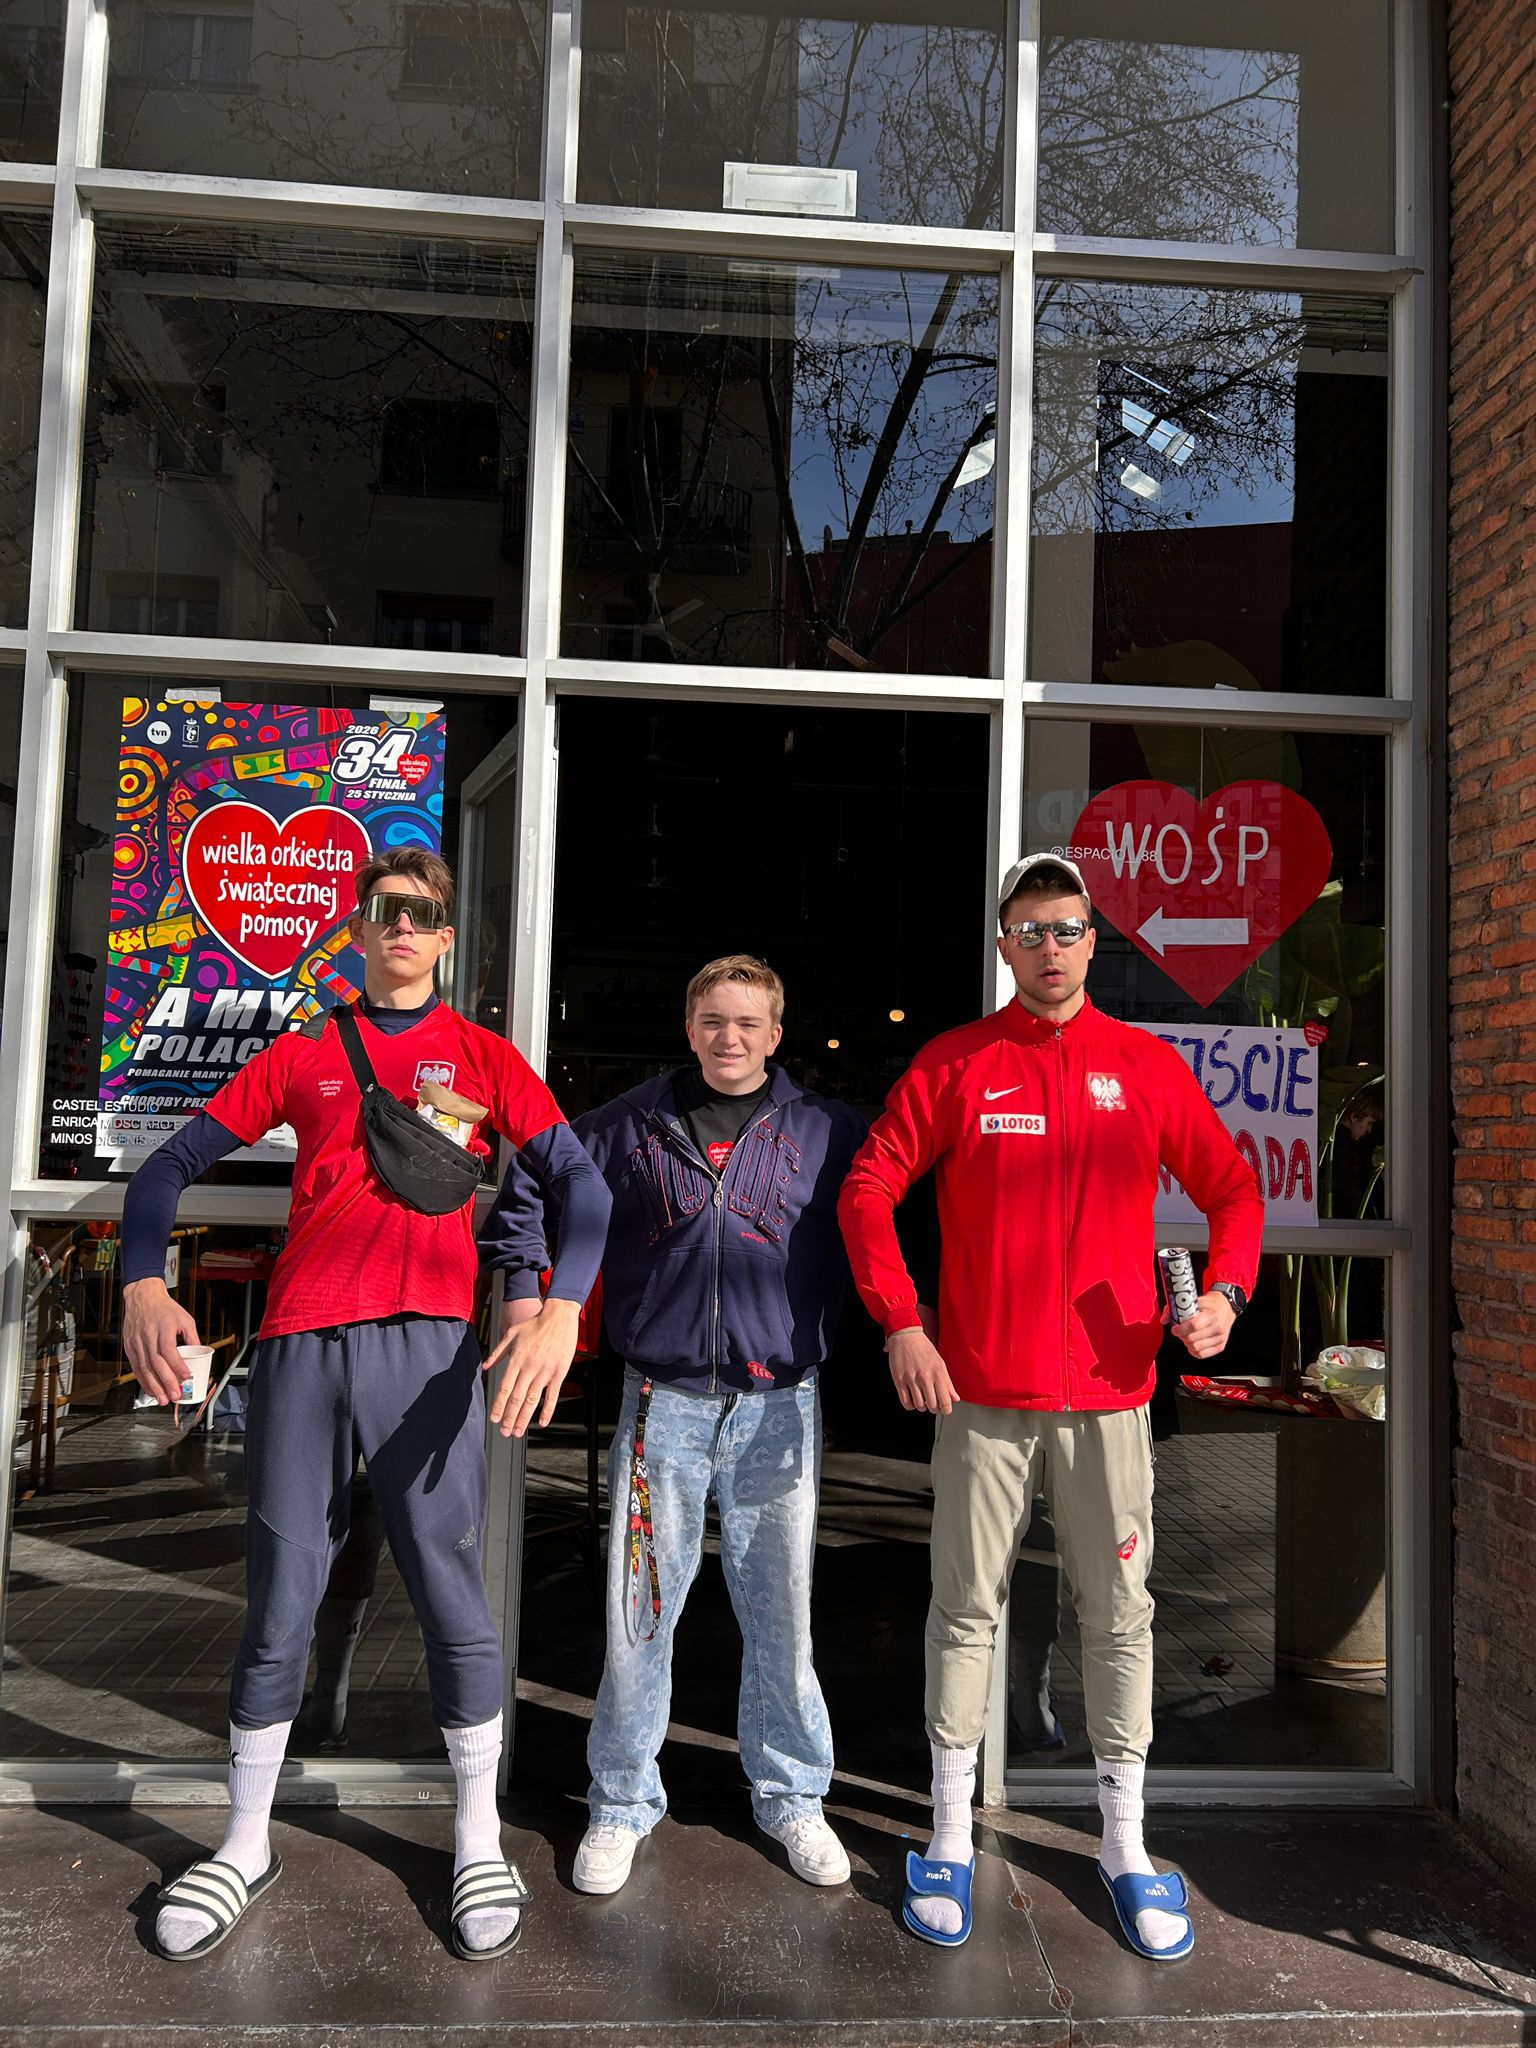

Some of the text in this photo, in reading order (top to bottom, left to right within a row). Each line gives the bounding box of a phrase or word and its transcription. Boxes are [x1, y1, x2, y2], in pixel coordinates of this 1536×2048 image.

[150, 727, 167, 736] tvn
[346, 725, 379, 734] 2026
[333, 730, 415, 783] 34
[346, 789, 416, 801] 25 STYCZNIA
[201, 832, 354, 872] wielka orkiestra
[1105, 806, 1269, 887] WOŚP
[217, 870, 338, 920] świątecznej
[239, 912, 319, 949] pomocy
[145, 986, 191, 1028] A
[132, 1033, 275, 1064] POLAC
[127, 1067, 190, 1079] POMAGANIE
[191, 1070, 226, 1079] MAMY
[53, 1098, 159, 1113] CASTEL ESTUDIO
[52, 1115, 98, 1127] ENRICA
[1001, 1117, 1040, 1131] LOTOS
[50, 1132, 93, 1145] MINOS
[926, 1871, 951, 1881] KUBOTA
